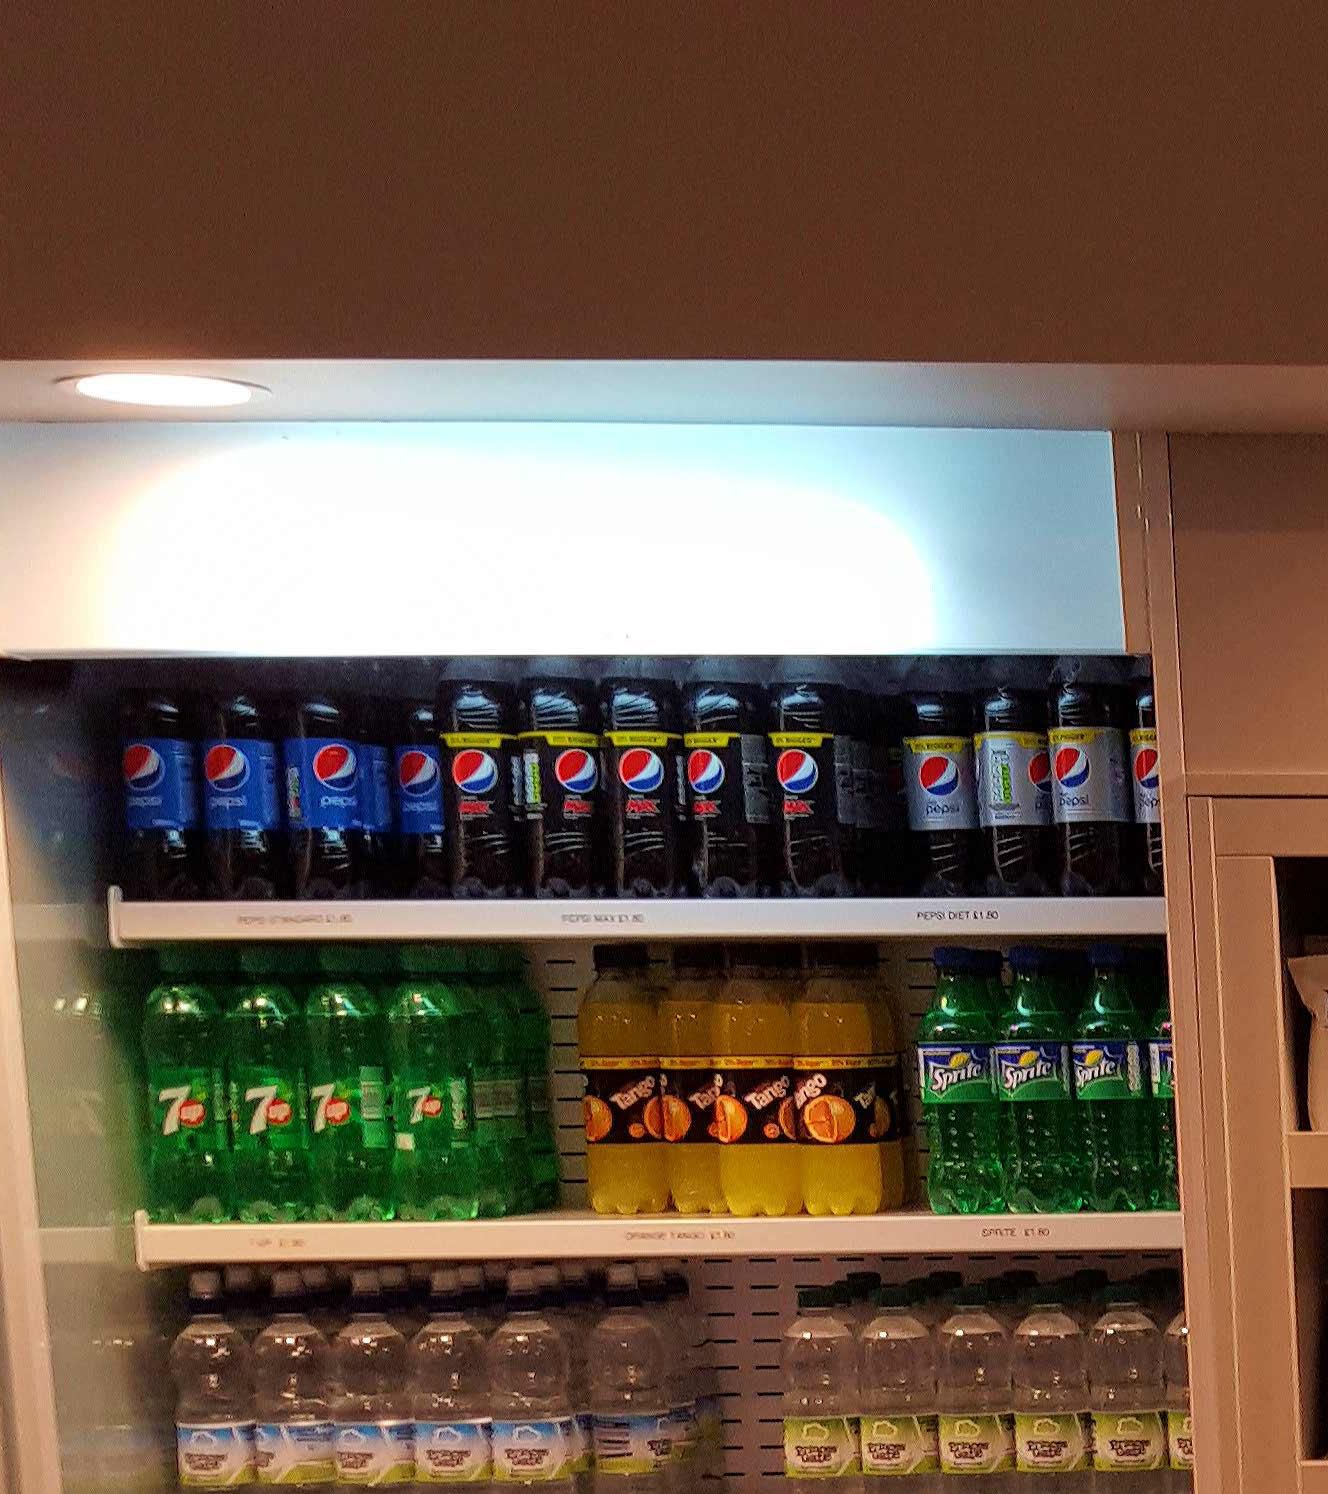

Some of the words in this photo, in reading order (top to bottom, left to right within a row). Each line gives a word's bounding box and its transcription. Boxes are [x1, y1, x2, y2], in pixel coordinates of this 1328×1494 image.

[931, 1062, 983, 1091] Sprite
[1004, 1061, 1051, 1090] Sprite
[1076, 1060, 1116, 1087] Sprite
[609, 1075, 656, 1110] Tango
[744, 1074, 790, 1110] Tango
[794, 1073, 827, 1110] ango
